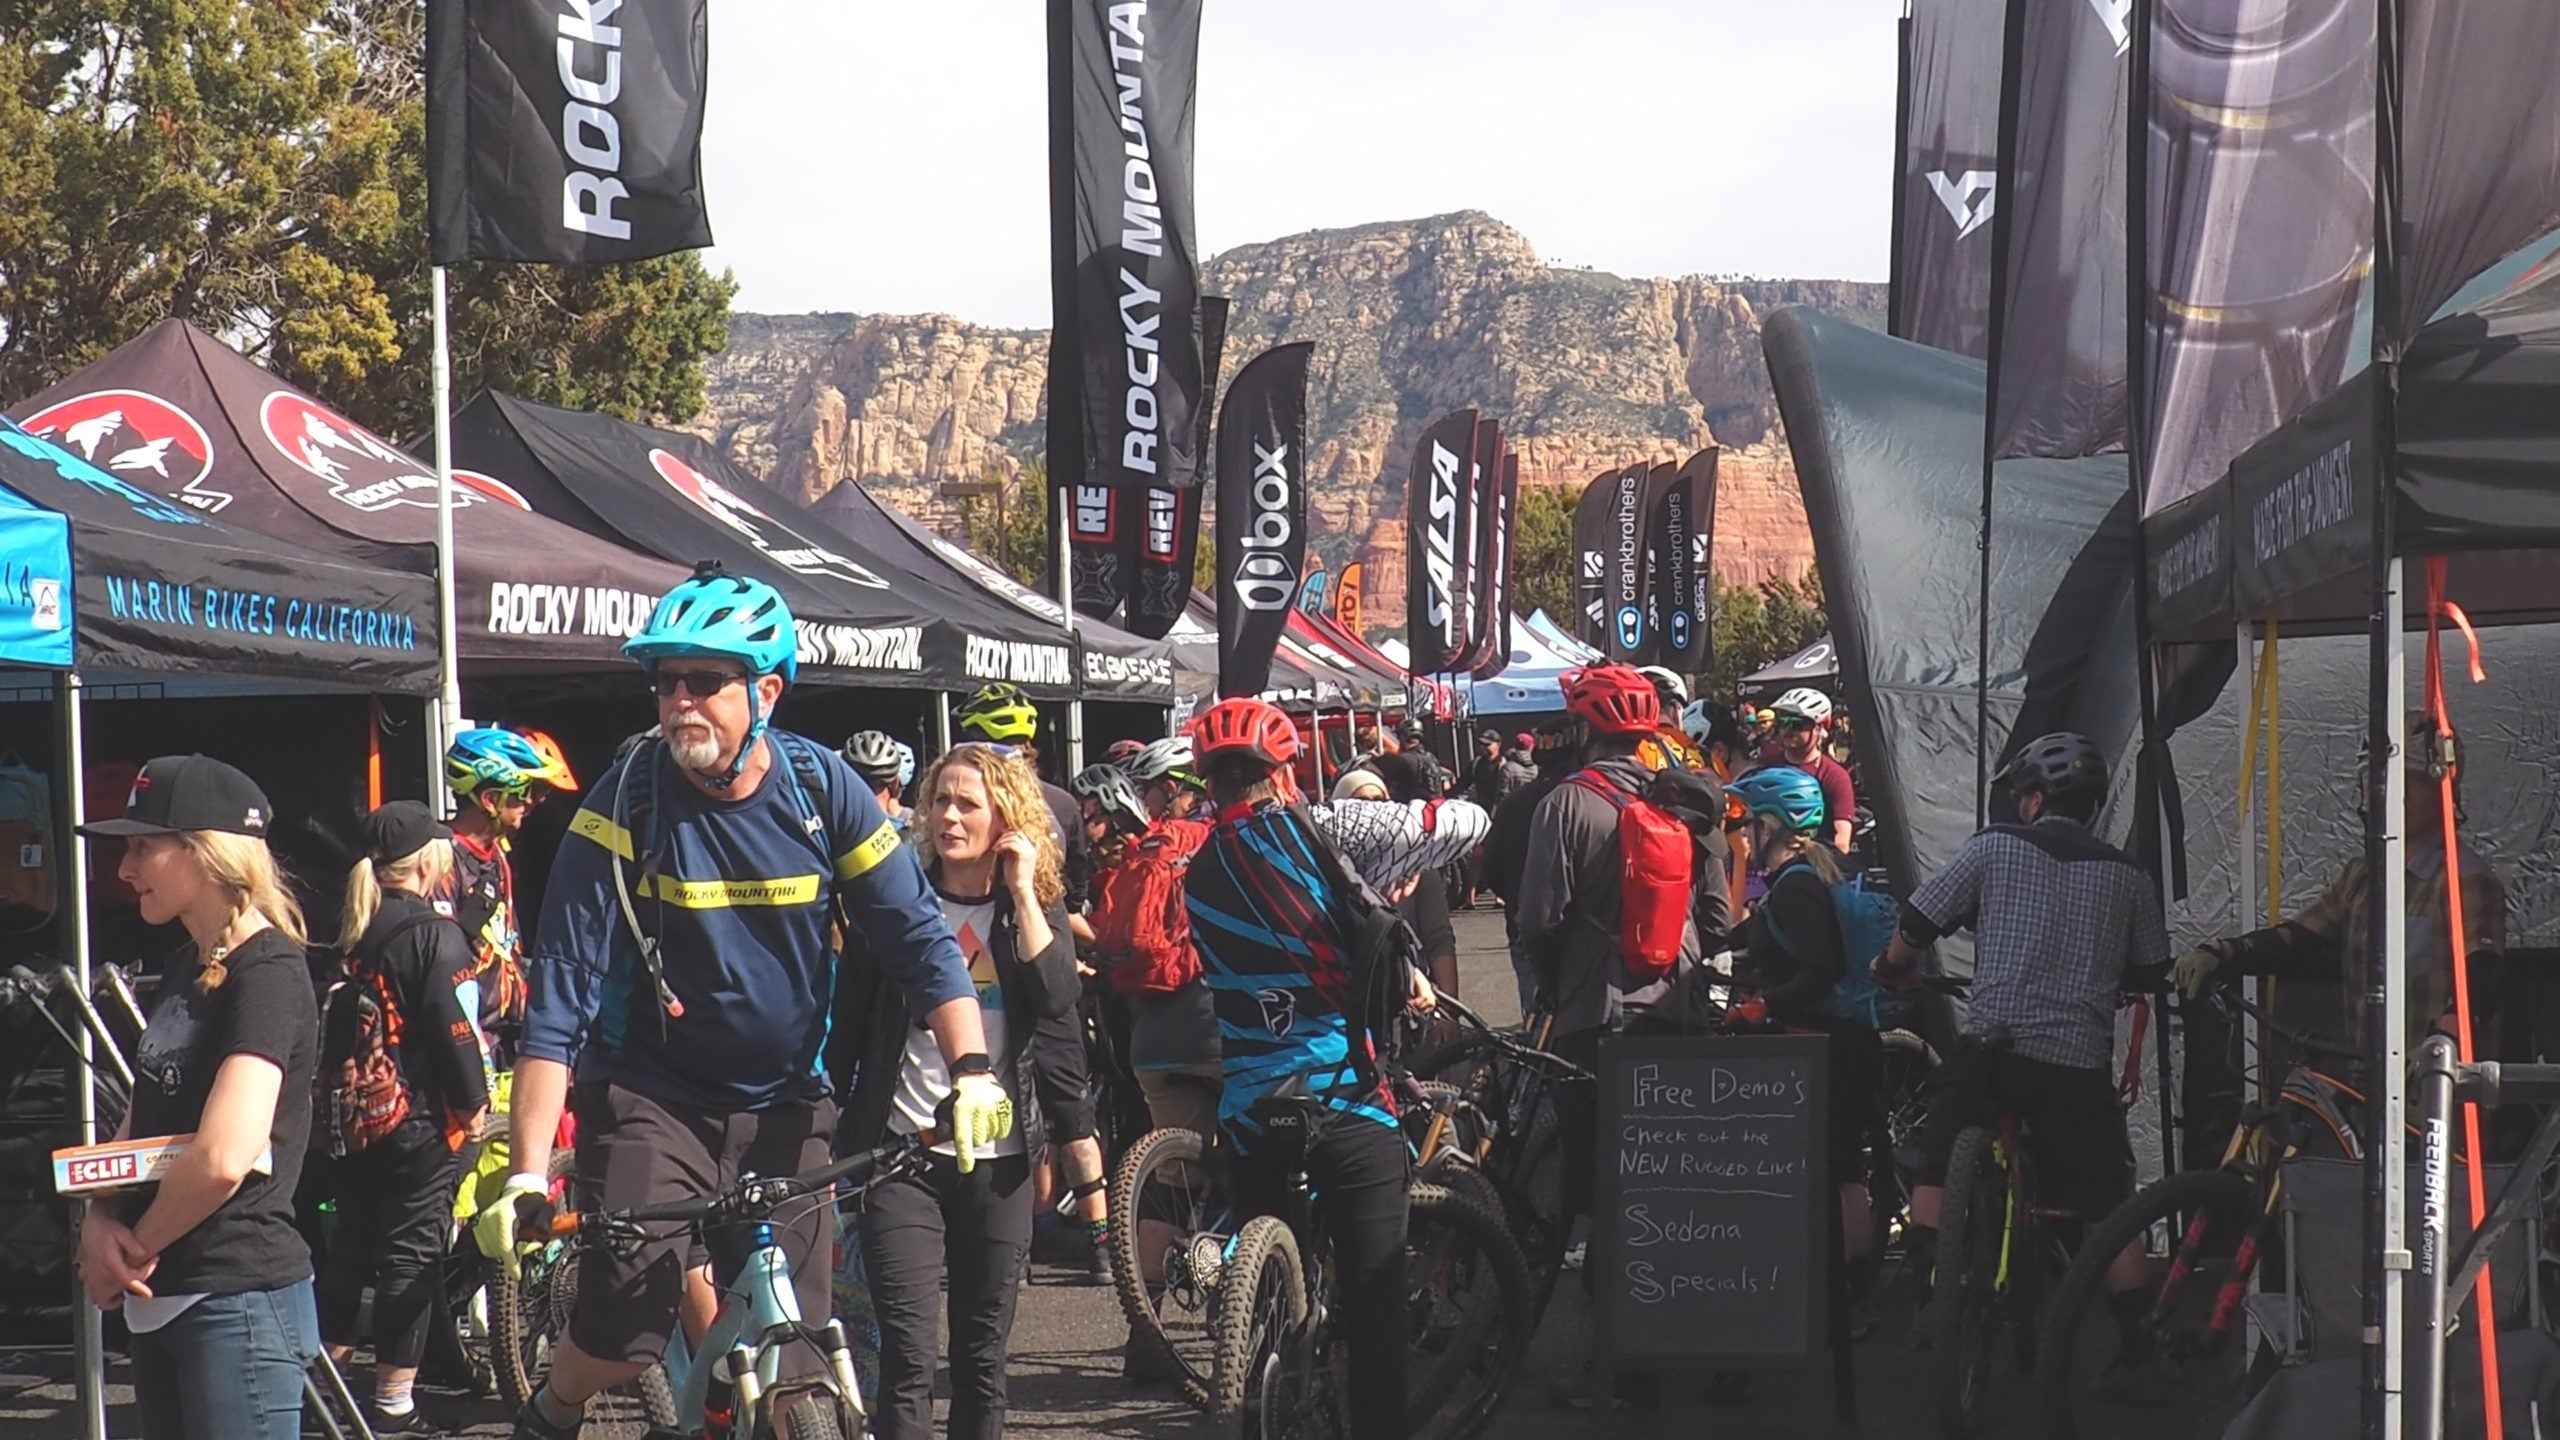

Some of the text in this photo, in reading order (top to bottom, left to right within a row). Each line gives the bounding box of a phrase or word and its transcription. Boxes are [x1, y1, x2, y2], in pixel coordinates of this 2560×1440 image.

[1119, 266, 1161, 474] ROCKY
[1240, 442, 1291, 547] box
[1427, 439, 1459, 648] SALSA
[1619, 477, 1636, 601] crankbrothers
[1667, 492, 1684, 605] crankbrothers
[106, 575, 415, 650] MARIN BIKES CALIFORNIA
[488, 582, 580, 635] ROCKY
[965, 634, 1009, 680] ROCKY
[674, 886, 796, 900] ROCKY MOUNTAIN
[1634, 1064, 1805, 1107] Free Demo's
[1623, 1125, 1770, 1146] Check out the
[82, 1158, 133, 1181] CLIF
[1619, 1149, 1669, 1175] NEW
[2422, 1117, 2448, 1275] FEEDBACK SPORTS
[1625, 1203, 1742, 1247] Sedona
[1626, 1260, 1779, 1303] Specials!
